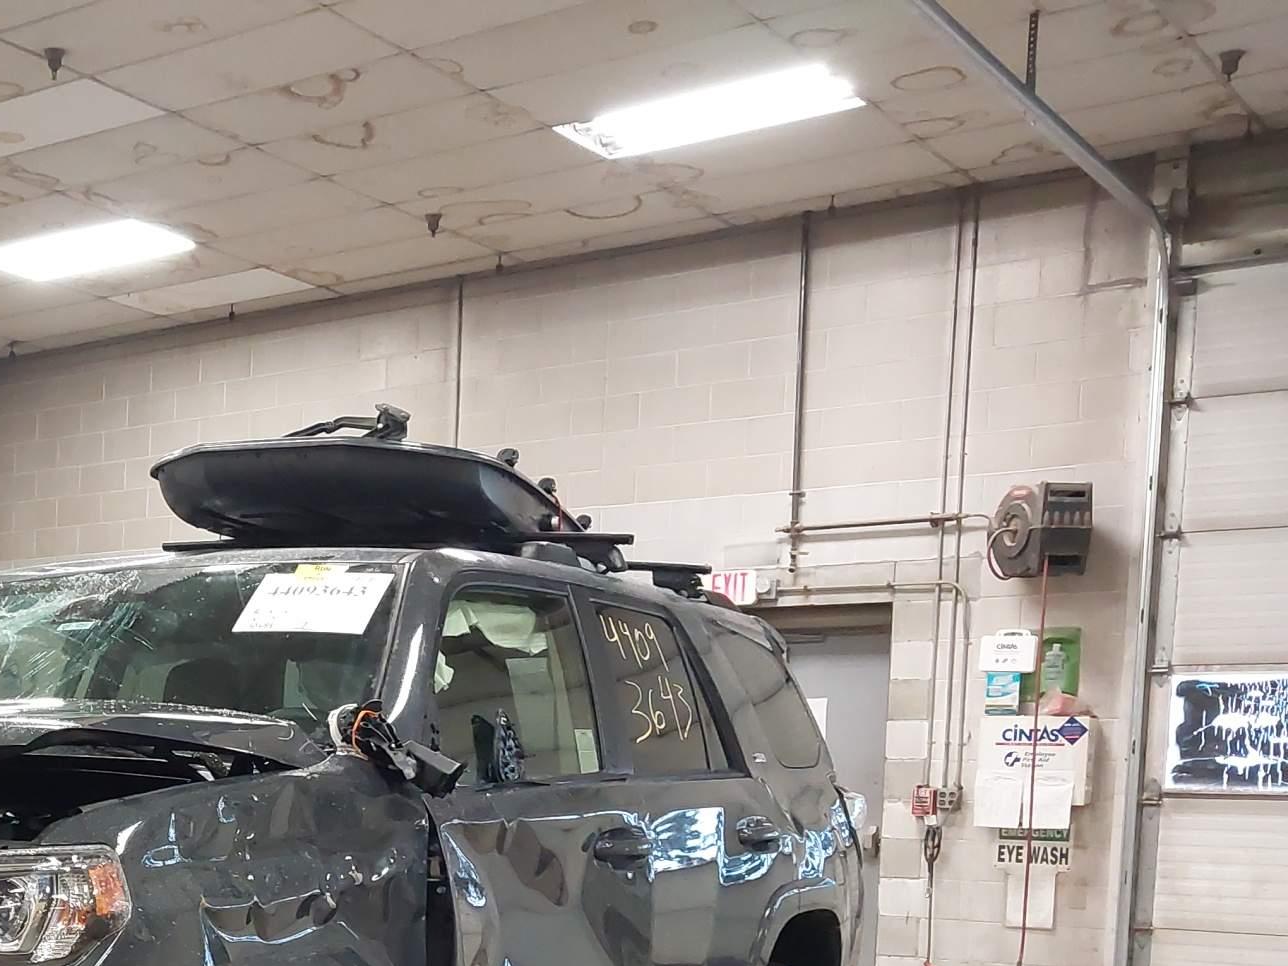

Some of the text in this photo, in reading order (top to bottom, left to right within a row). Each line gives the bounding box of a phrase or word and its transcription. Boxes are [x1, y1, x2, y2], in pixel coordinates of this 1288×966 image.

[267, 585, 368, 597] 44093643
[712, 572, 749, 602] EXIT
[599, 614, 670, 673] 4409
[624, 675, 693, 744] 3643
[997, 844, 1069, 865] EYE WASH
